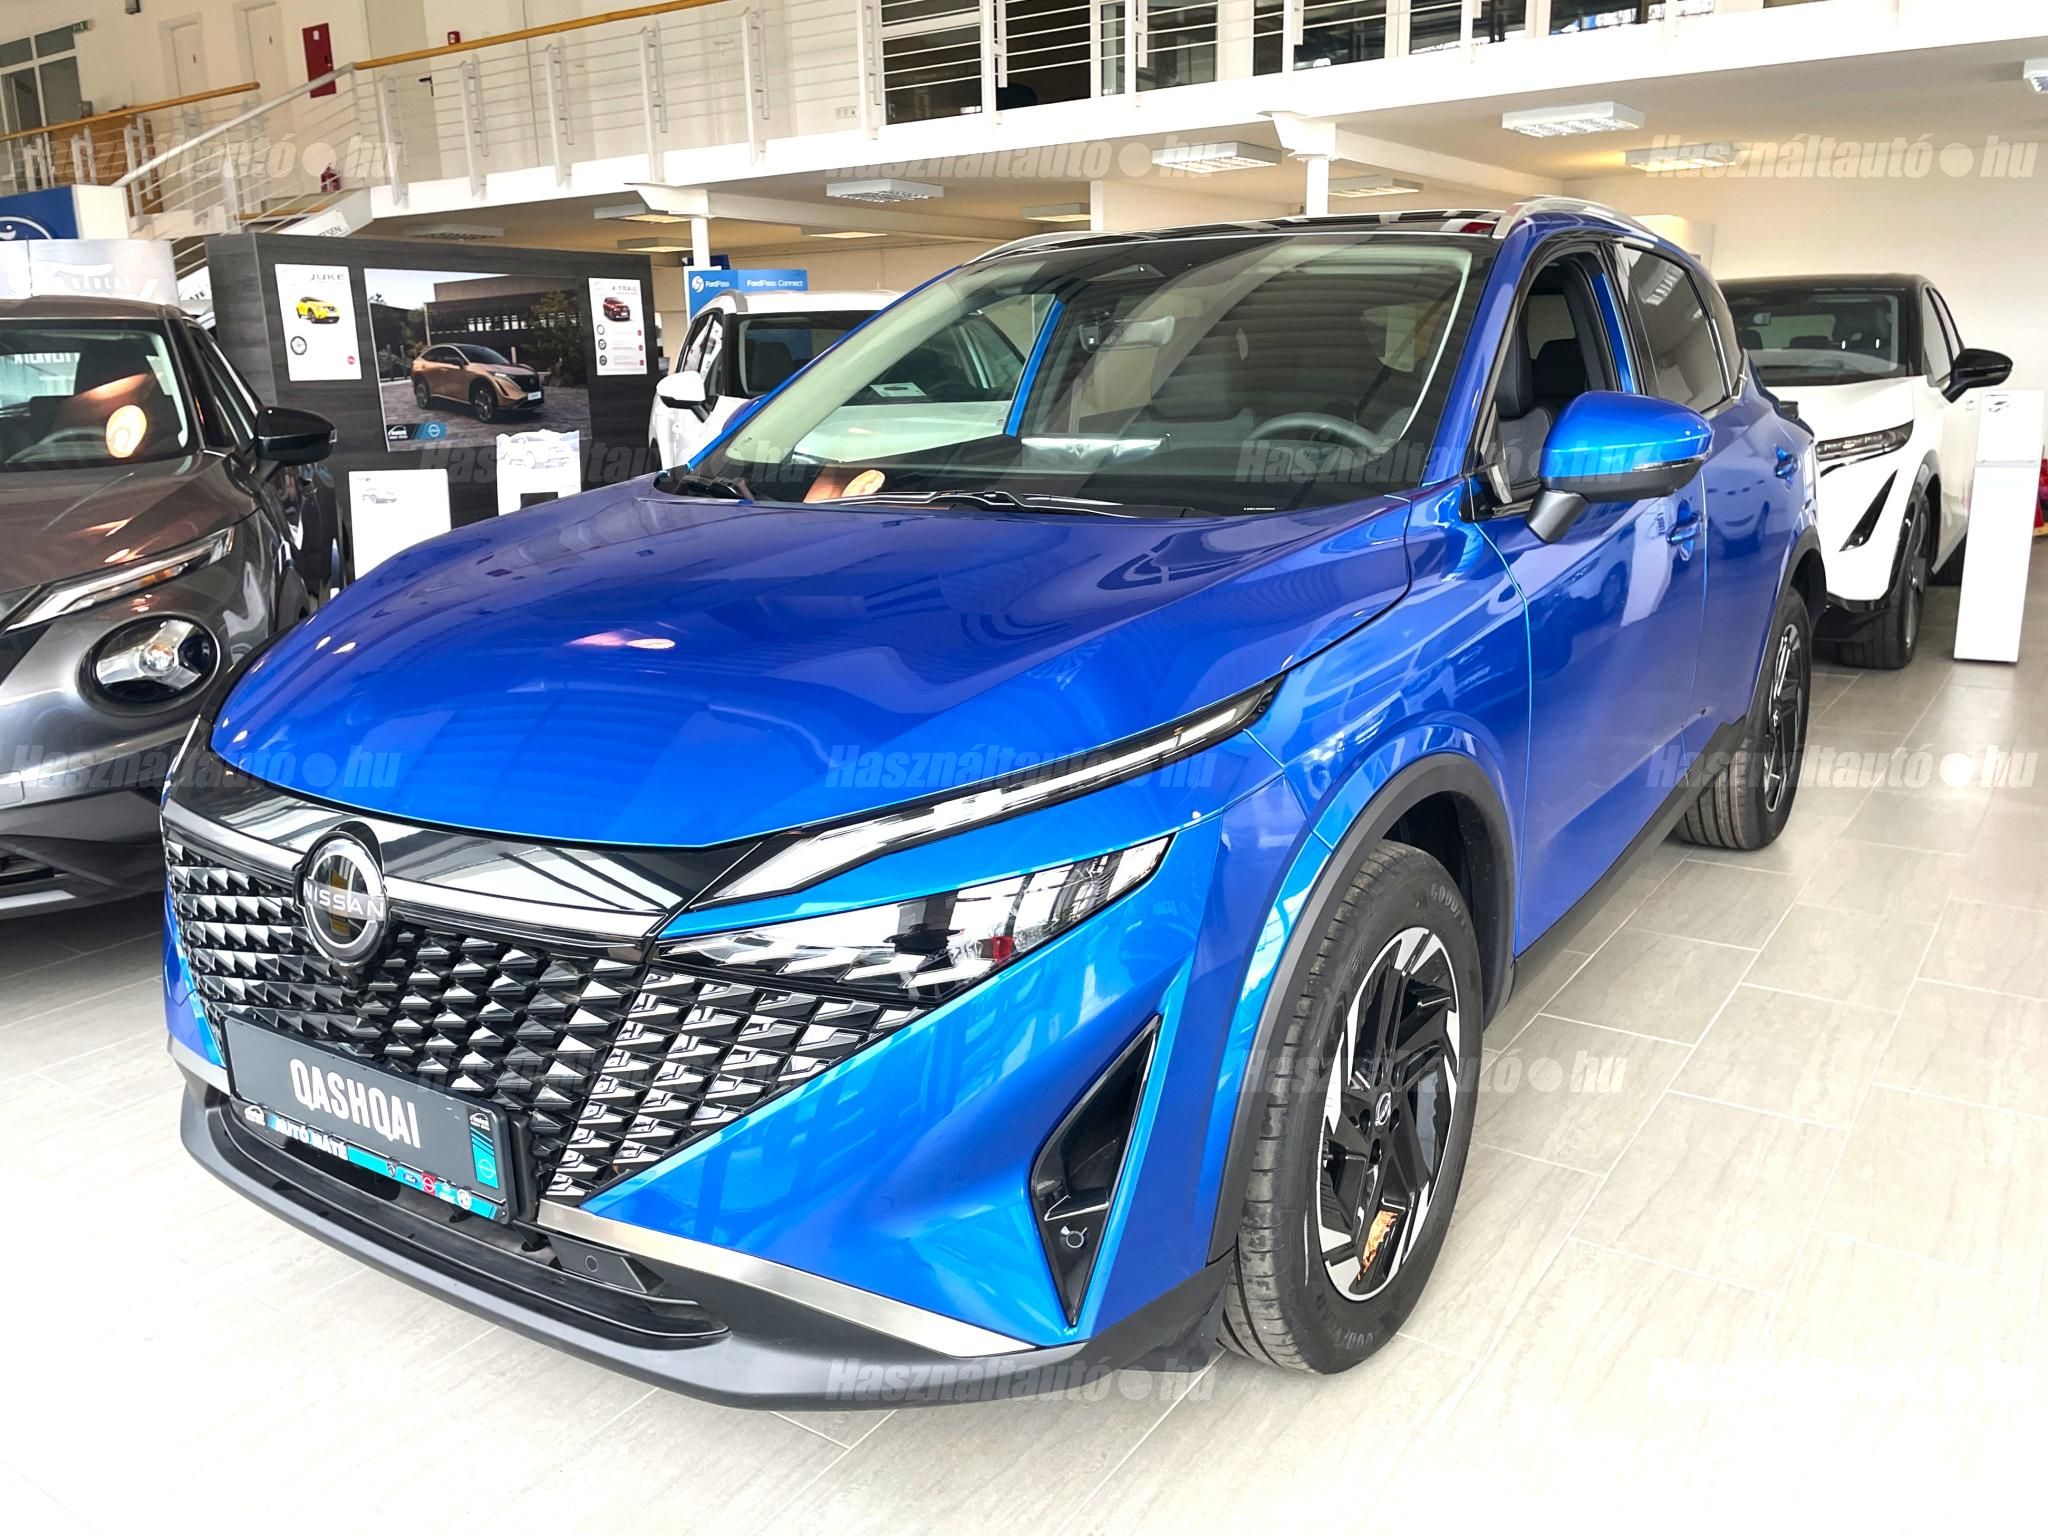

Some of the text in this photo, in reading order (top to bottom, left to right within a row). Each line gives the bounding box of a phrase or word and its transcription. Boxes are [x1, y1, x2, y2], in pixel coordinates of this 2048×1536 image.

[747, 279, 777, 287] FordPass
[303, 880, 384, 918] NISSAN
[290, 1059, 420, 1148] QASHQAI
